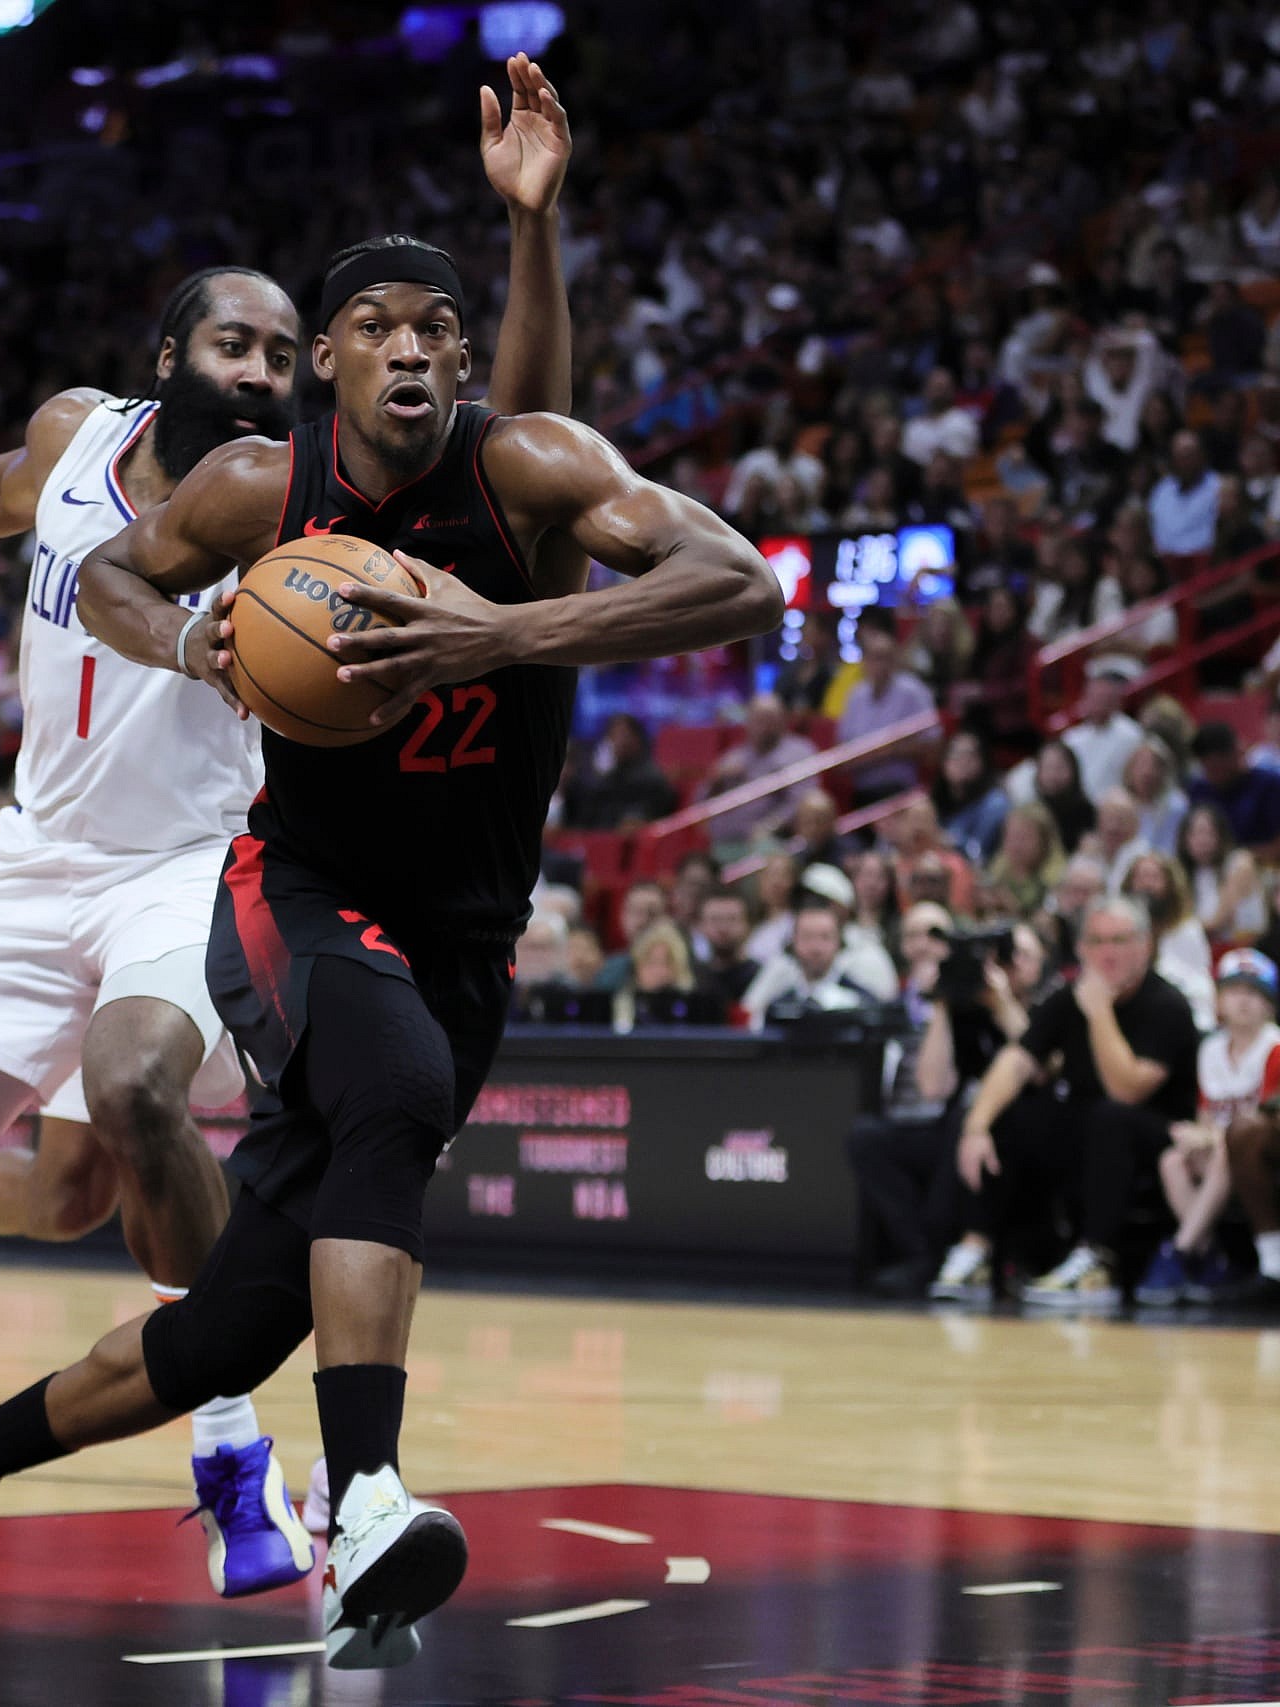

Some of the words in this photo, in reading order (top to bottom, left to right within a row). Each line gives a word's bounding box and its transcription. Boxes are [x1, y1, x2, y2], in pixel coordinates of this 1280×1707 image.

[283, 566, 388, 633] ilson
[77, 655, 96, 739] 1
[399, 684, 497, 772] 22
